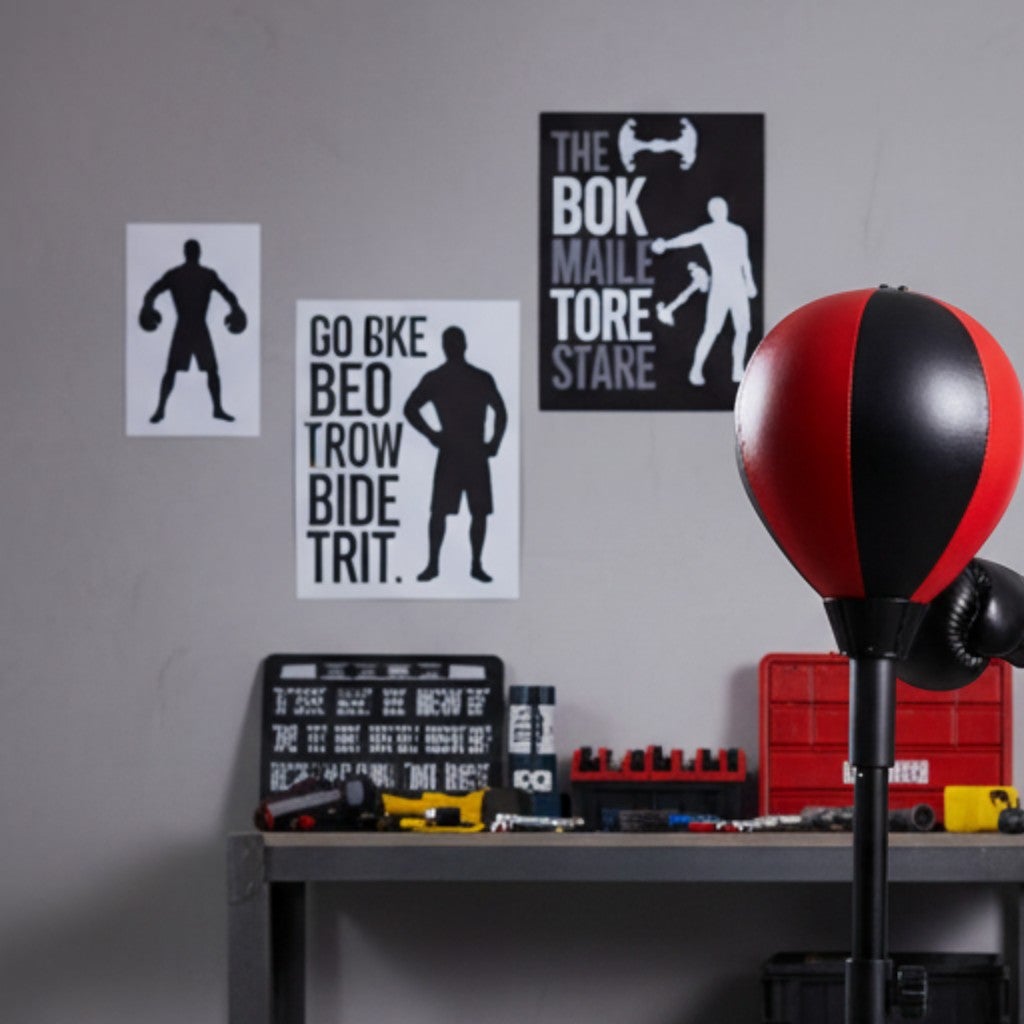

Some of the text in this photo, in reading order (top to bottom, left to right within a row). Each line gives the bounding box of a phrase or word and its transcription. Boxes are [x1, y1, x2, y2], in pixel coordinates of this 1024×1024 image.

[552, 131, 609, 173] THE
[552, 176, 648, 236] BOK
[551, 239, 654, 285] MAILE
[310, 315, 427, 358] GO BKE
[550, 288, 652, 341] TORE
[310, 362, 391, 417] BEO
[552, 344, 656, 390] STARE
[305, 422, 403, 468] TROW
[309, 473, 400, 527] BIDE
[307, 531, 402, 583] TRIT.
